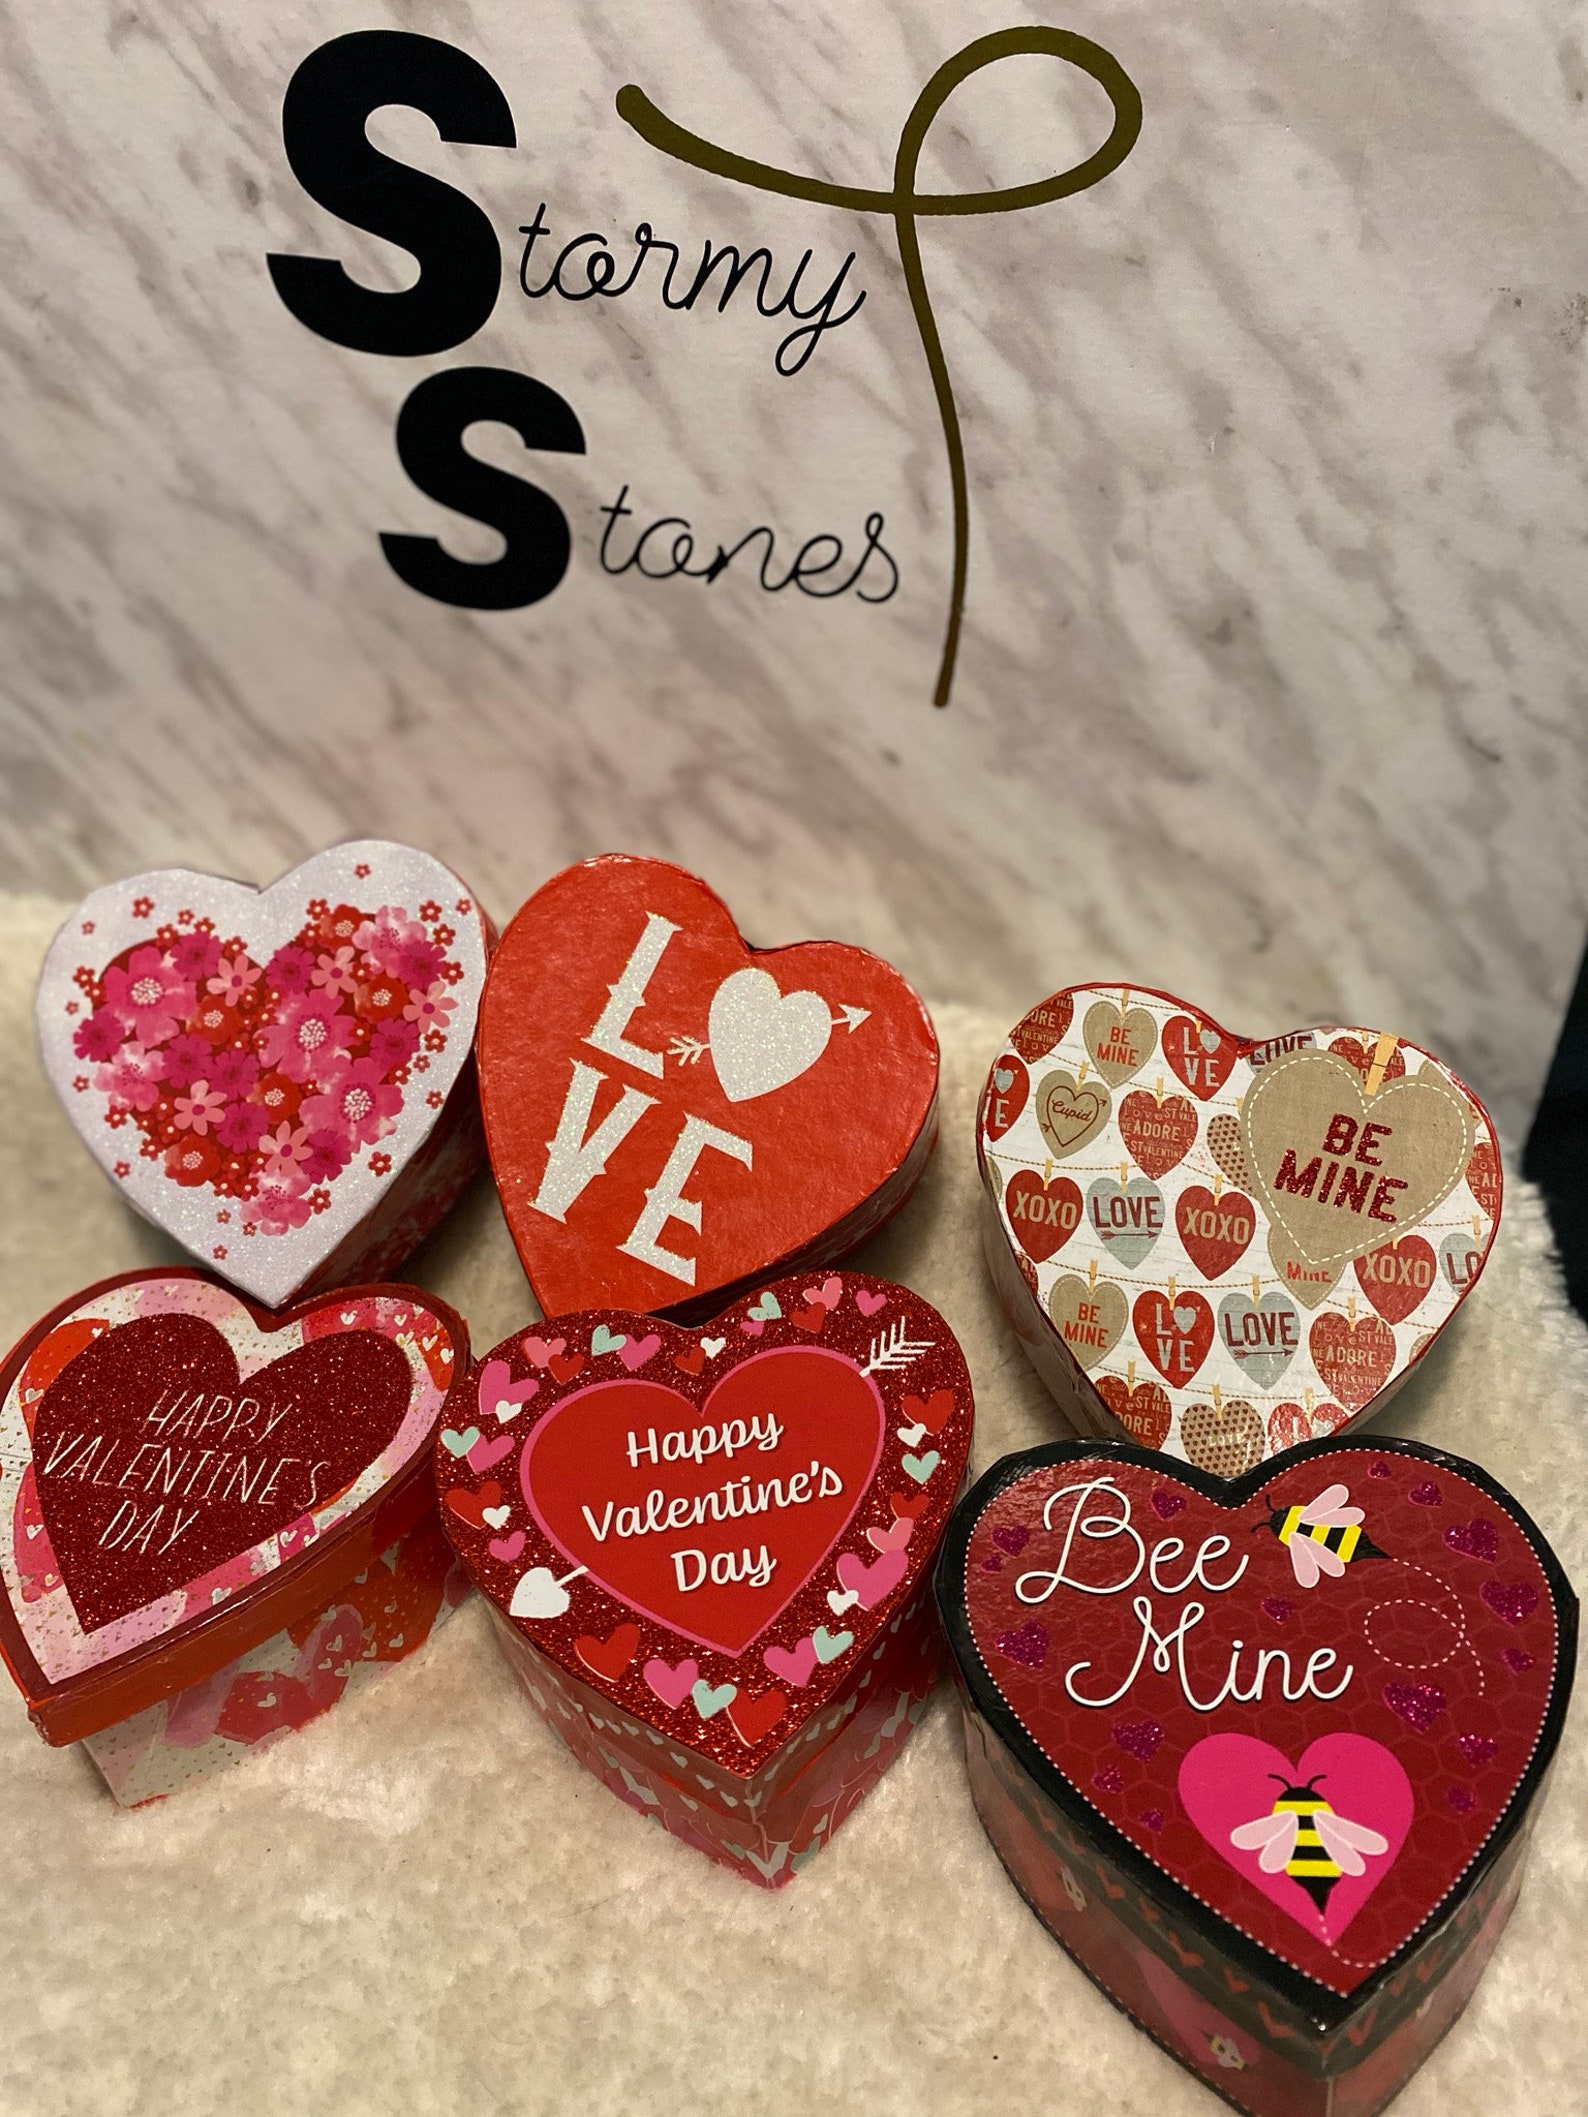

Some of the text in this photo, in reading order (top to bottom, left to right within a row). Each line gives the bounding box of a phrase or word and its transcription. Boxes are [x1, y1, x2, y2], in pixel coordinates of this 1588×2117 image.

[266, 29, 867, 376] Stormy
[378, 366, 899, 613] Stones
[1096, 1043, 1139, 1067] MINE
[1110, 1026, 1130, 1045] BE
[1052, 1099, 1093, 1122] Cupid
[1133, 1120, 1180, 1141] ADORE
[1322, 1113, 1393, 1167] BE
[1274, 1149, 1408, 1223] MINE
[1013, 1191, 1077, 1229] XOXO
[1093, 1196, 1163, 1228] LOVE
[1183, 1207, 1250, 1245] XOXO
[1362, 1255, 1430, 1288] XOXO
[1064, 1320, 1108, 1348] MINE
[1078, 1302, 1100, 1324] BE
[1224, 1312, 1298, 1347] LOVE
[1326, 1345, 1377, 1368] ADORE
[141, 1389, 293, 1444] HAPPY
[626, 1412, 784, 1468] Happy
[43, 1432, 331, 1507] VALENTINE'S
[581, 1460, 844, 1543] Valentine's
[98, 1501, 200, 1555] DAY
[1014, 1476, 1250, 1604] Bee
[670, 1544, 778, 1593] Day
[1064, 1595, 1354, 1711] Mine
